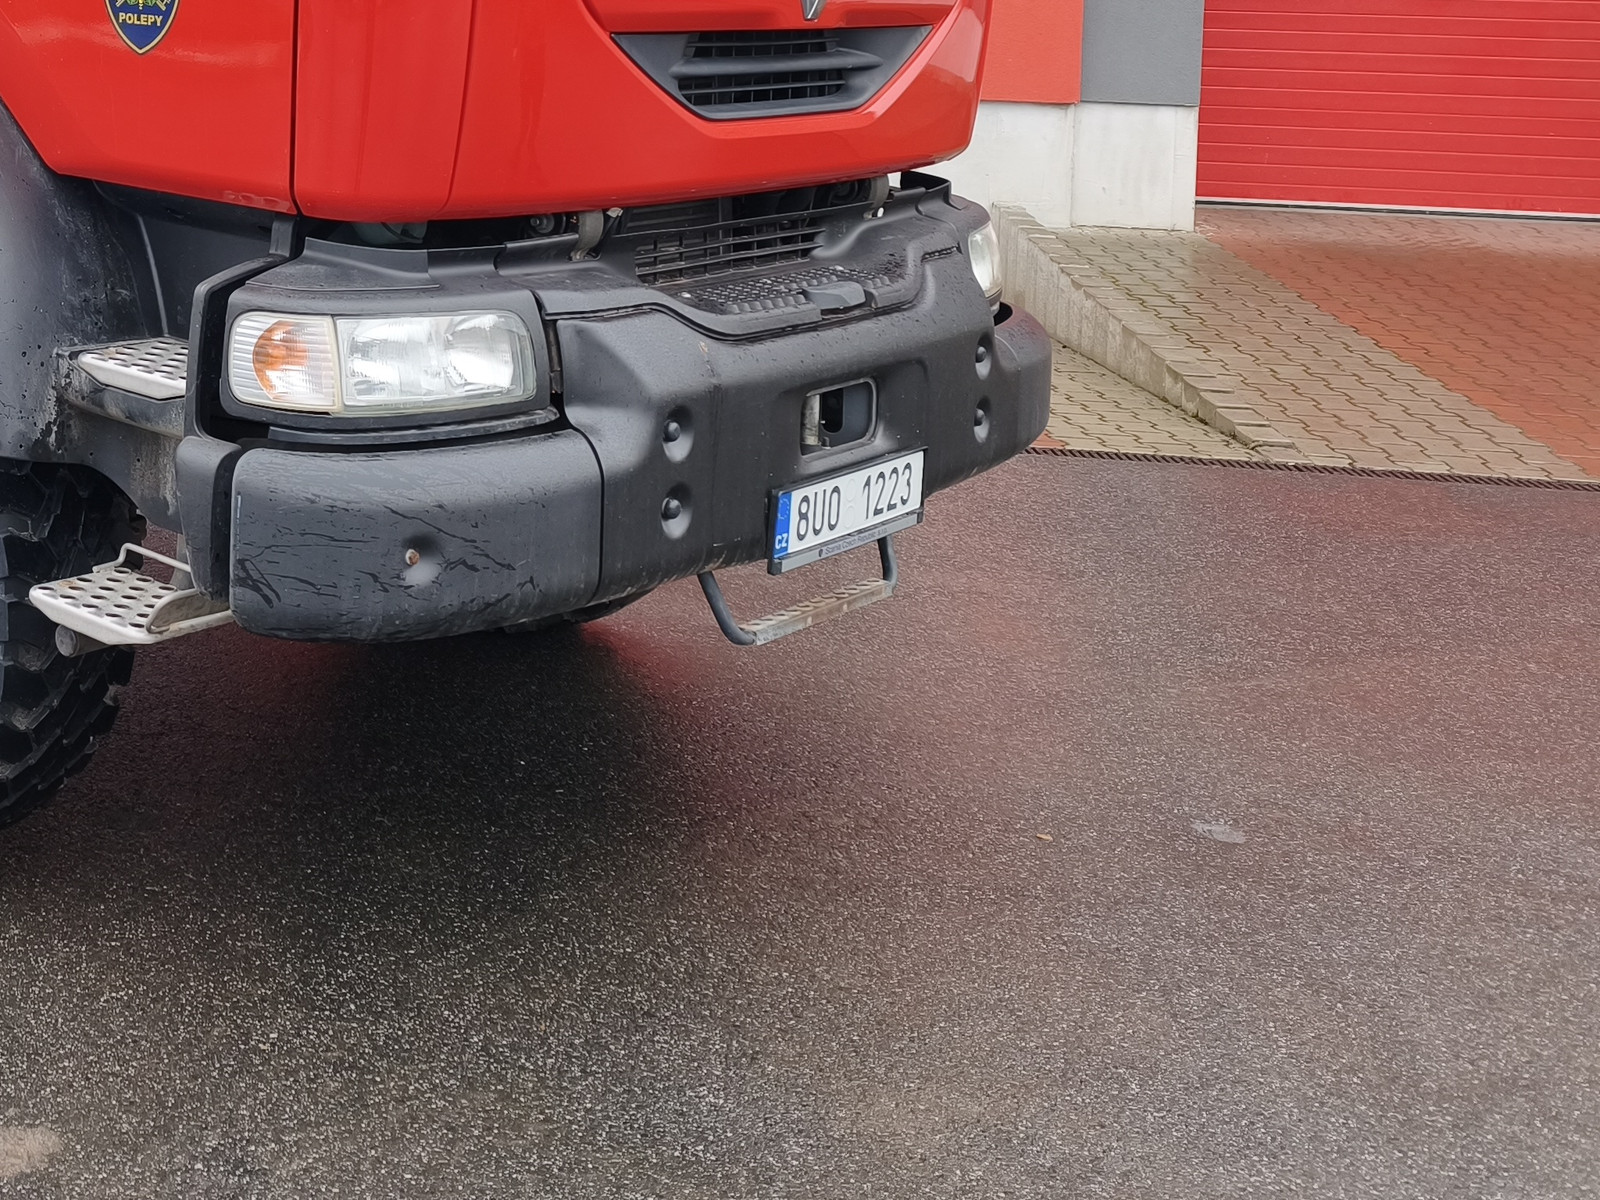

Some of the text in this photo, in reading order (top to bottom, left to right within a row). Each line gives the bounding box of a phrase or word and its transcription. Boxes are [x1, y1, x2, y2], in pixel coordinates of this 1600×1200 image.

[118, 12, 163, 27] POLEPY
[862, 462, 913, 520] 1223
[774, 533, 788, 550] CZ
